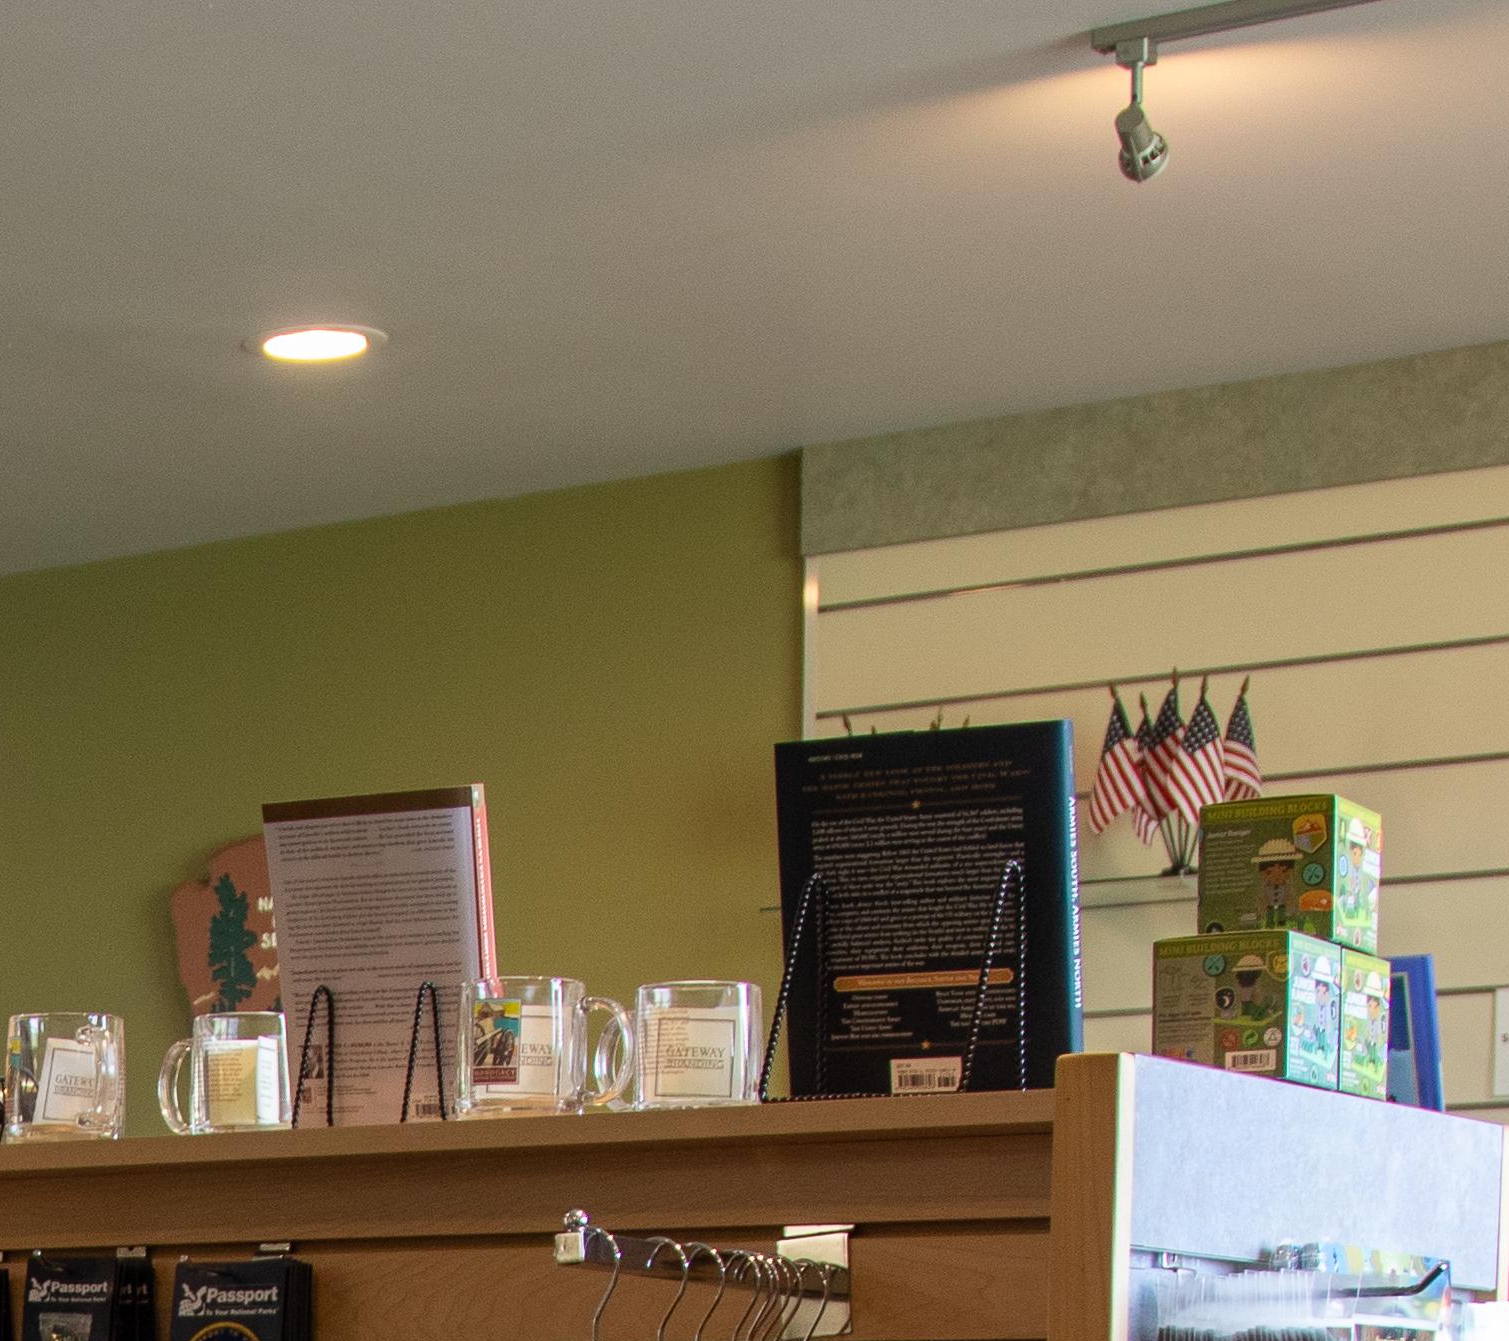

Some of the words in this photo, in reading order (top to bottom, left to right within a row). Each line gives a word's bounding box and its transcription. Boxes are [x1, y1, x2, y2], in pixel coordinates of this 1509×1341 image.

[1069, 797, 1079, 845] ARMIES
[1072, 905, 1081, 955] ARMIES
[1074, 957, 1082, 1009] NORTH
[521, 1045, 553, 1056] EWAY
[50, 1280, 108, 1296] Passport
[206, 1285, 280, 1305] Passport
